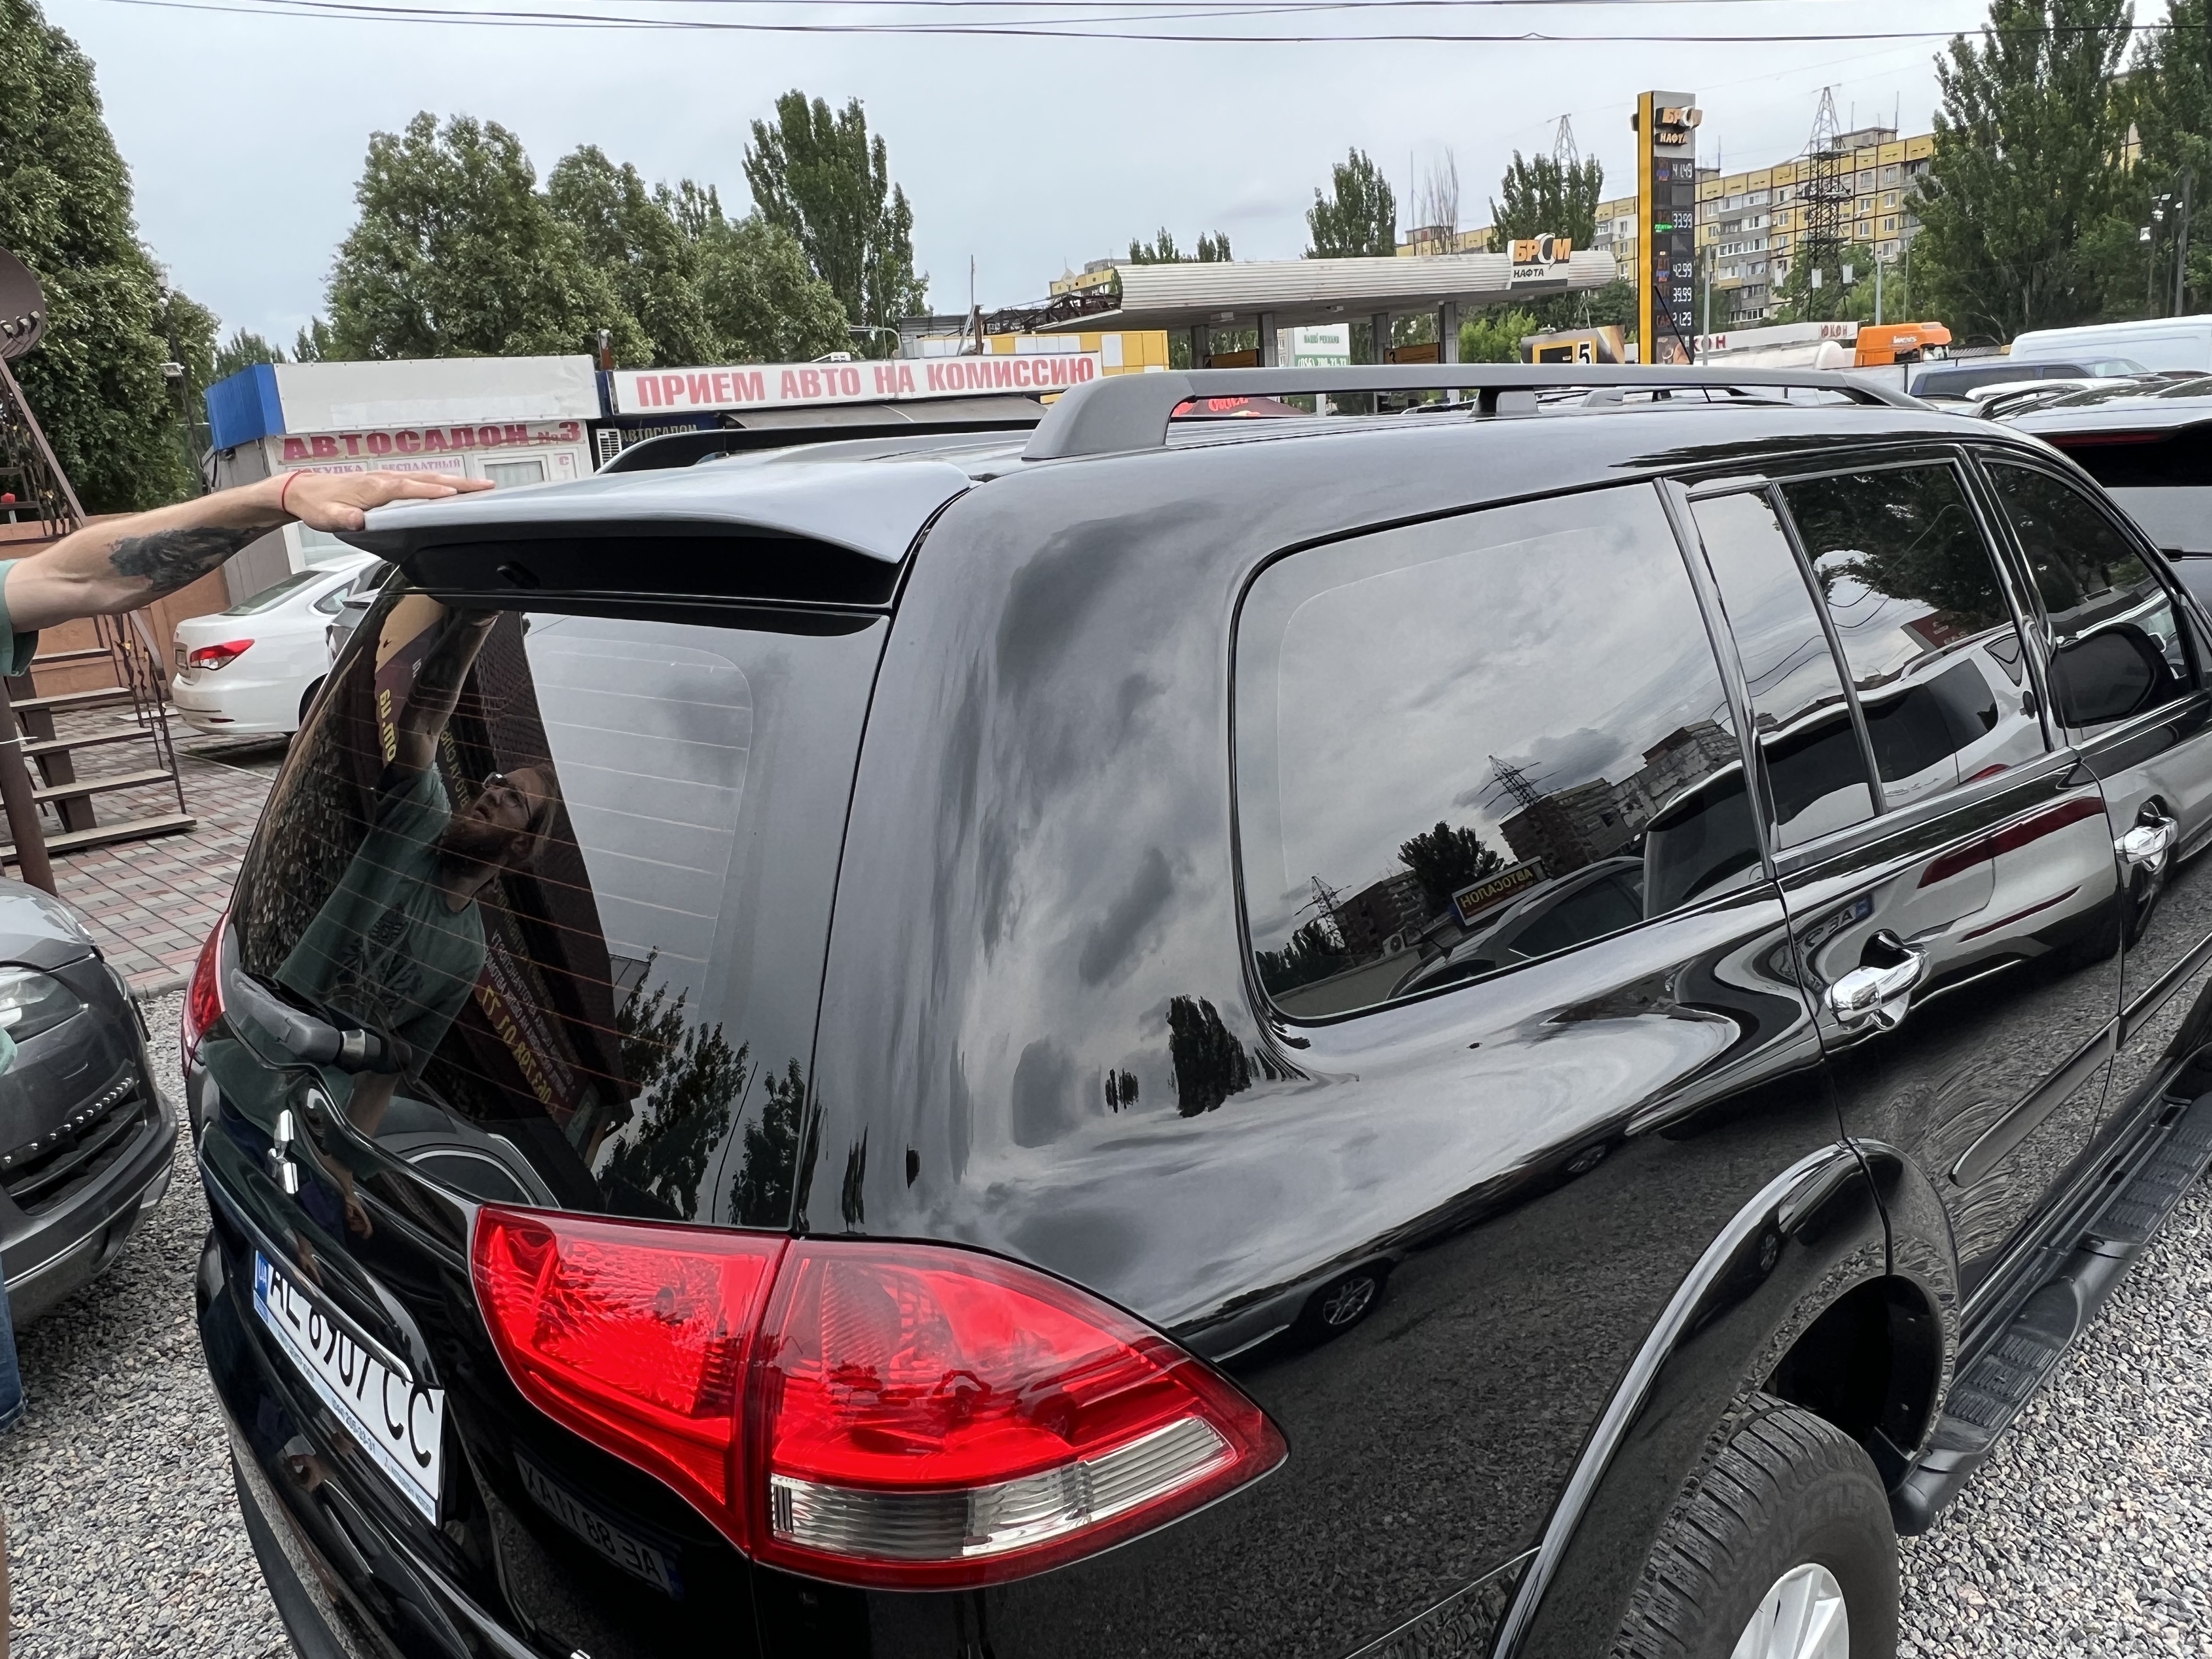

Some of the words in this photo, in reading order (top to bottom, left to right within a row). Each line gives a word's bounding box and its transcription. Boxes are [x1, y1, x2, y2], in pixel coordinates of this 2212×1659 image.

[1514, 233, 1572, 265] БРСМ
[1514, 268, 1544, 278] НАФТА
[1578, 340, 1590, 363] 5
[636, 371, 765, 407] ПРИЕМ
[781, 368, 861, 400] АВТО
[874, 365, 916, 394] НА
[927, 358, 1094, 392] КОМИССИЮ
[284, 424, 529, 460] АВТОСАЛОН
[559, 421, 581, 442] 3
[383, 1369, 434, 1469] CC
